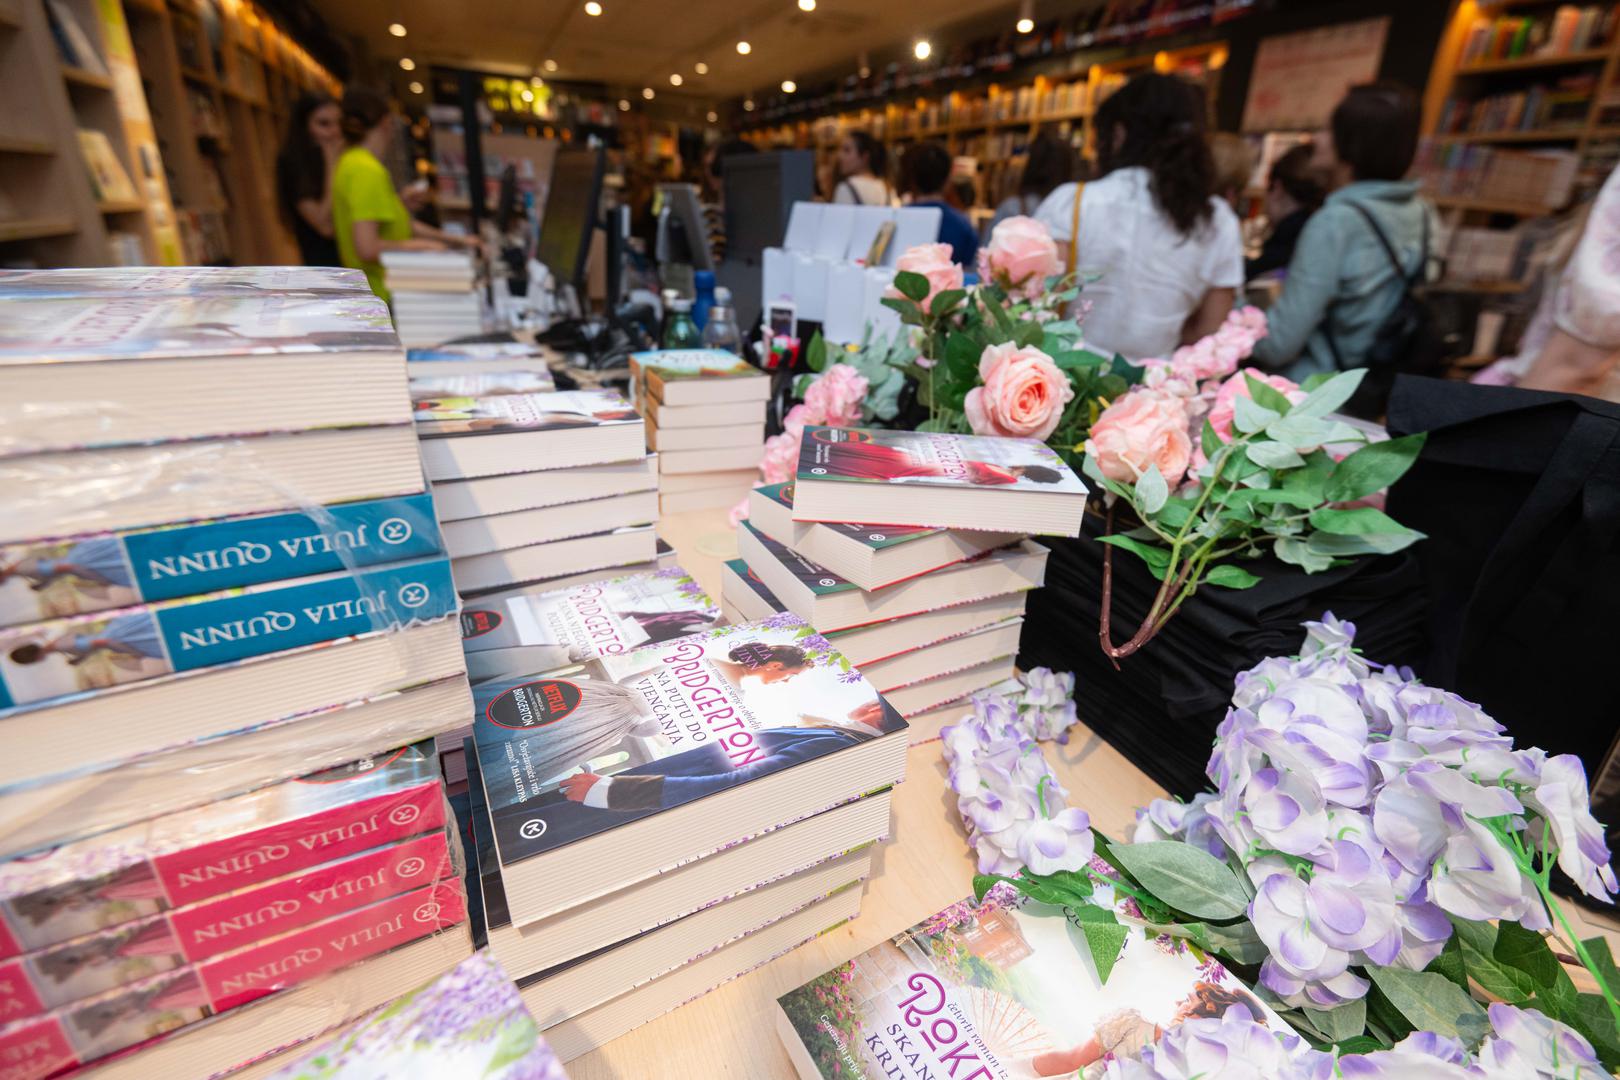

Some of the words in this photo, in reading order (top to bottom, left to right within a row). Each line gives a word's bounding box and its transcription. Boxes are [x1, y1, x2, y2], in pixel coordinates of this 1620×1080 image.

[278, 524, 367, 558] JULIA
[149, 542, 272, 582] QUINN
[302, 590, 386, 625] JULIA
[569, 587, 624, 656] BRIDGERTO
[180, 610, 296, 651] QUINN
[513, 688, 534, 726] BRIDGERTON
[541, 684, 568, 714] NETFLIX
[636, 677, 684, 745] VJENČANJA
[654, 671, 672, 687] NA
[665, 687, 695, 719] PUTU
[686, 721, 707, 742] DO
[662, 643, 766, 768] BRIDGERTON
[514, 776, 527, 803] KLEYPAS
[296, 814, 378, 850] JULIA
[178, 845, 289, 888] QUINN
[307, 867, 386, 905] JULIA
[194, 899, 300, 944] QUINN
[330, 915, 404, 953] JULIA
[221, 948, 323, 995] QUINN
[820, 1014, 848, 1055] Generaciju
[843, 1055, 860, 1074] prije
[947, 1001, 976, 1032] četvrti
[971, 1033, 999, 1068] roman
